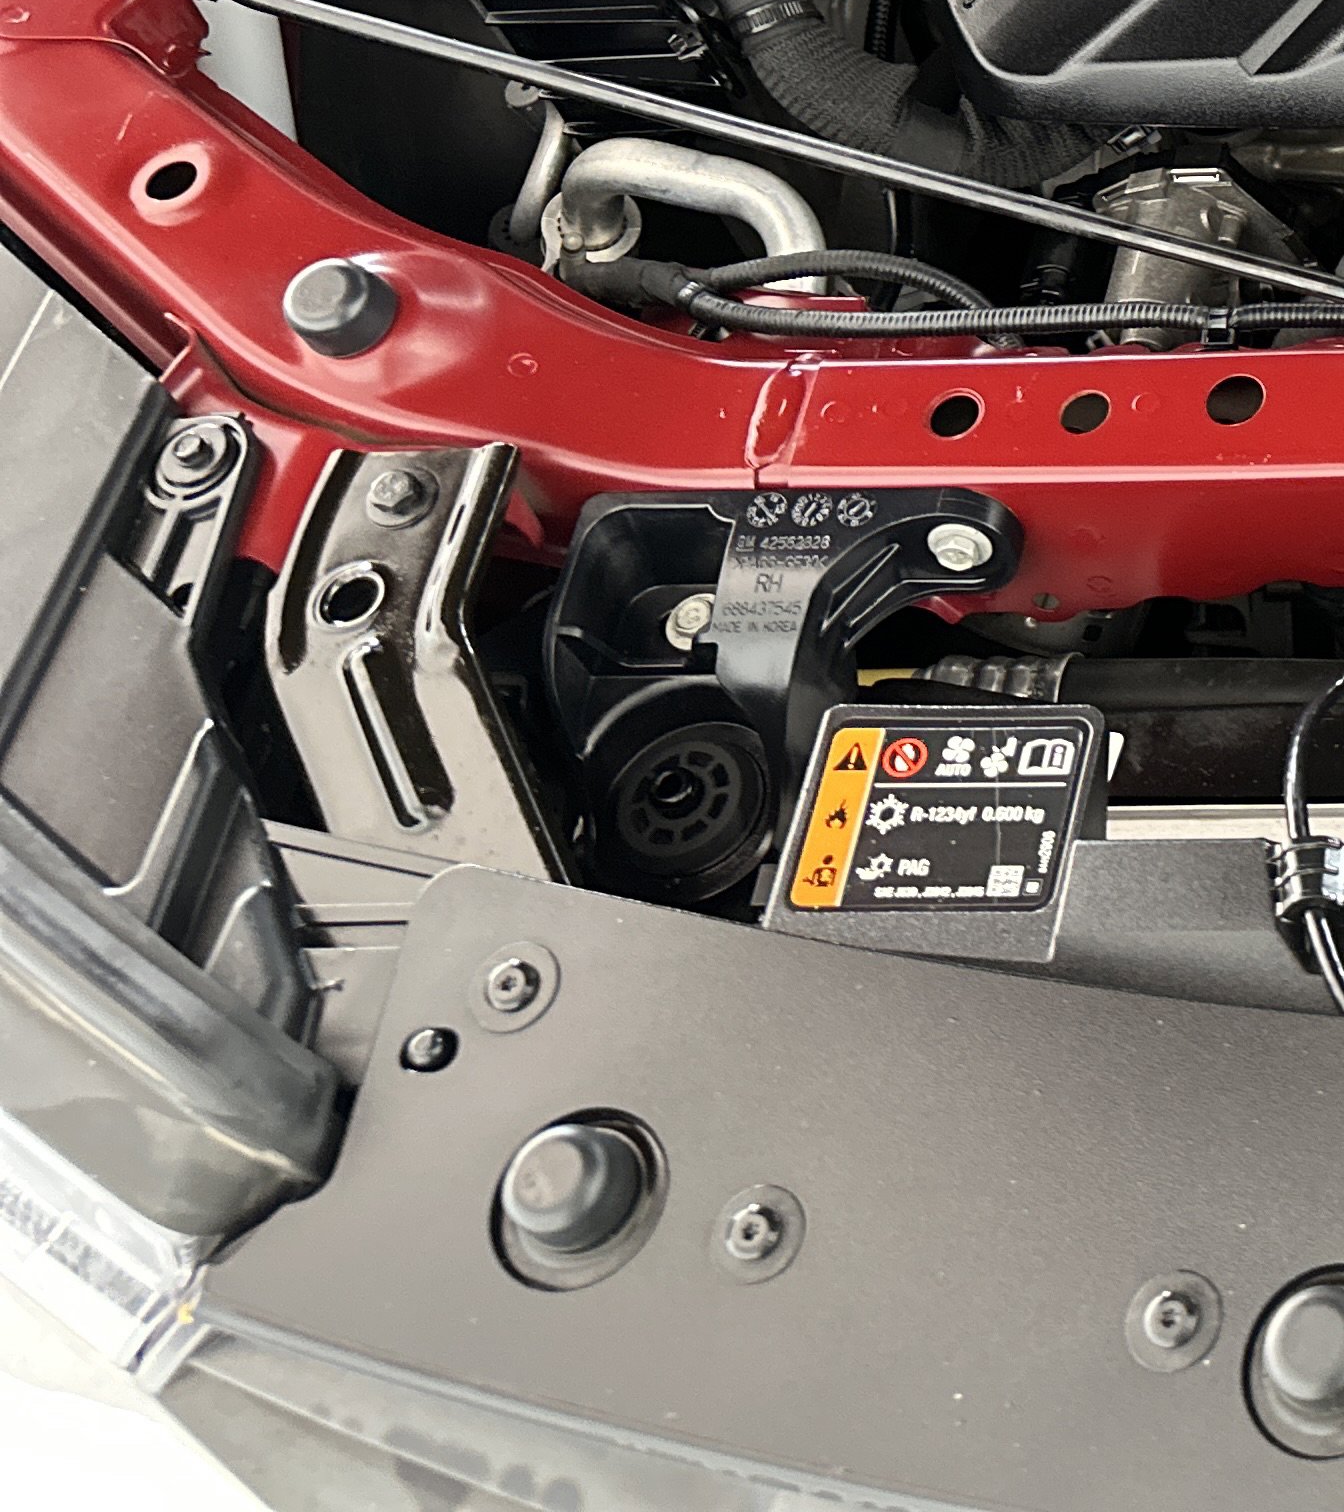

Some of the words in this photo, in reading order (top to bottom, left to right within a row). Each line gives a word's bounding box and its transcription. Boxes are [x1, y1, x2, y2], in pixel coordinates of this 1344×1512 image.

[754, 572, 784, 594] RH
[712, 620, 742, 633] MADE
[747, 620, 760, 632] IN
[764, 620, 797, 633] KOREA
[935, 764, 972, 777] AUTO
[910, 805, 977, 826] R-1234yf
[1024, 807, 1045, 825] kg
[897, 858, 930, 877] PAG
